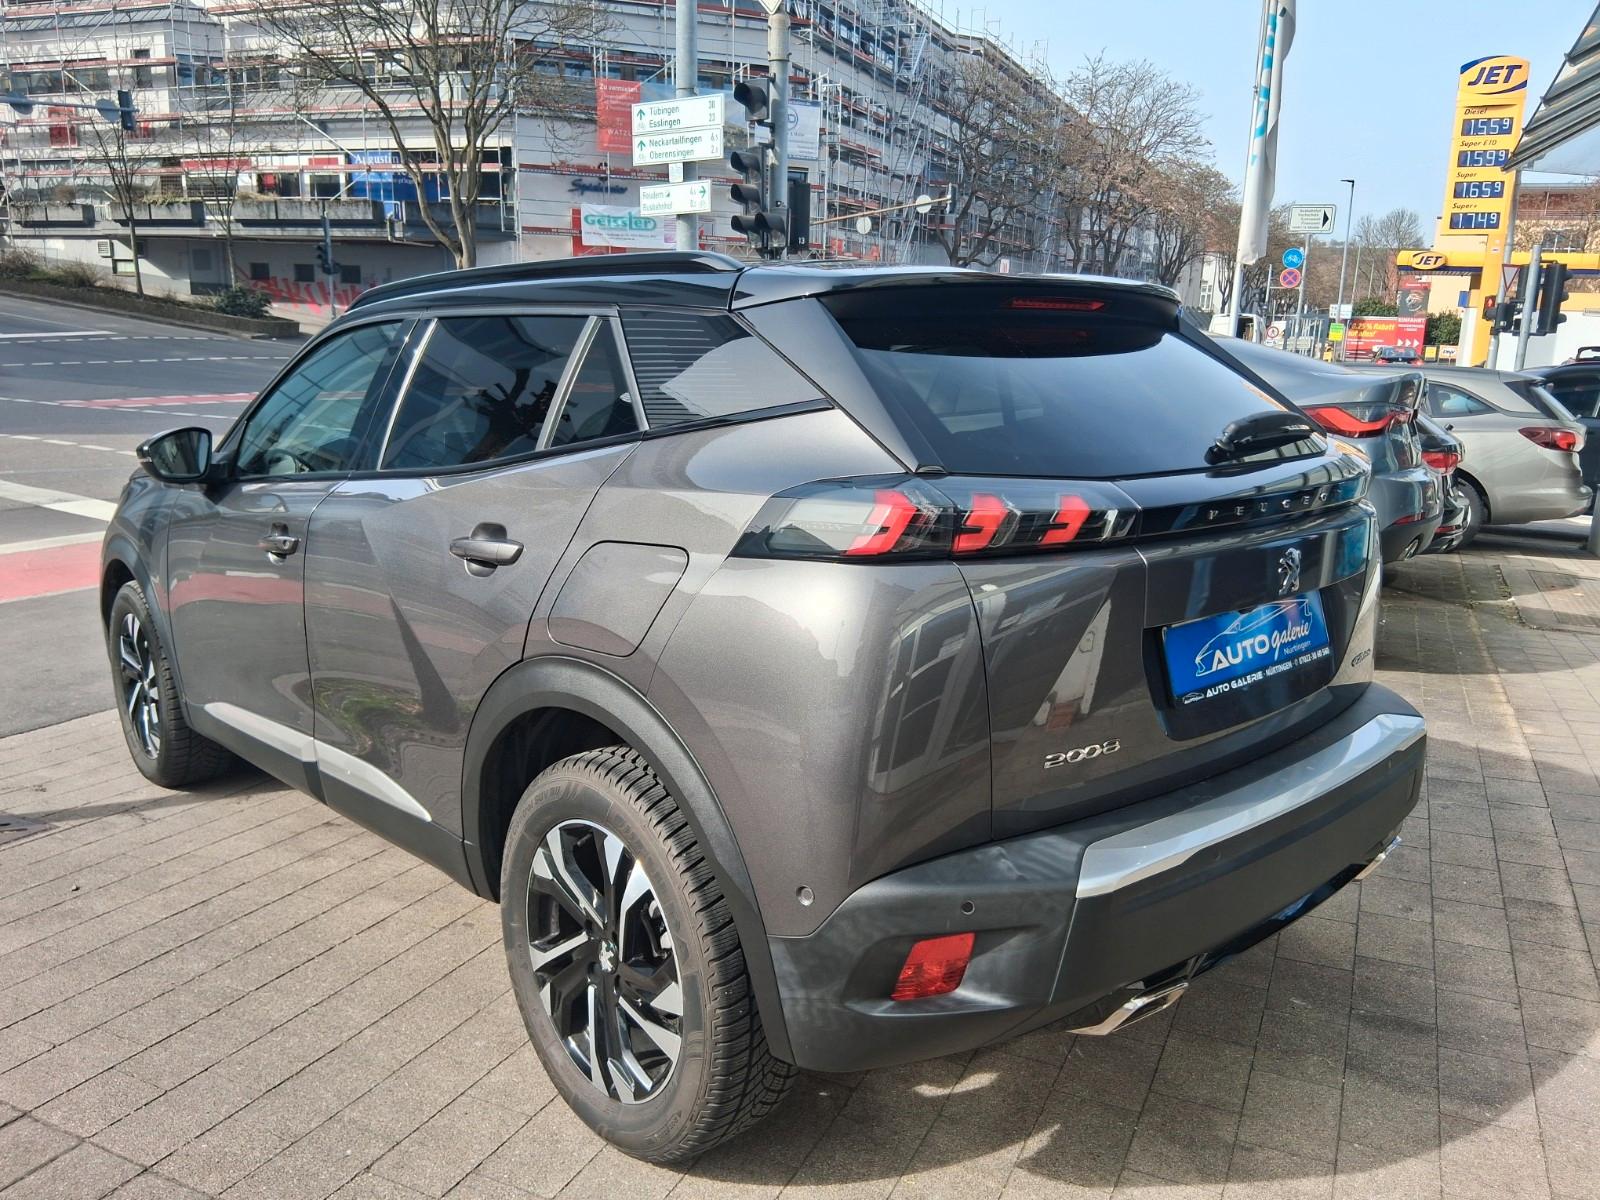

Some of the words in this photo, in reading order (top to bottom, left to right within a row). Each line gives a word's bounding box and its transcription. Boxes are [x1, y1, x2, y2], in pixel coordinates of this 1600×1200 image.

[1468, 65, 1523, 86] JET
[650, 105, 680, 116] Tübingen
[1464, 107, 1488, 115] Diesel
[649, 118, 681, 129] Esslingen
[649, 134, 702, 147] Neckartailfingen
[649, 148, 695, 159] Oberensingen
[583, 212, 656, 230] Geissler
[1415, 256, 1442, 266] JET
[1373, 322, 1395, 331] Rabatt
[1211, 633, 1270, 672] AUTO
[1271, 620, 1310, 661] galerie
[1206, 683, 1230, 698] AUTO
[1231, 671, 1264, 689] GALERIE
[1044, 739, 1120, 769] 2008
